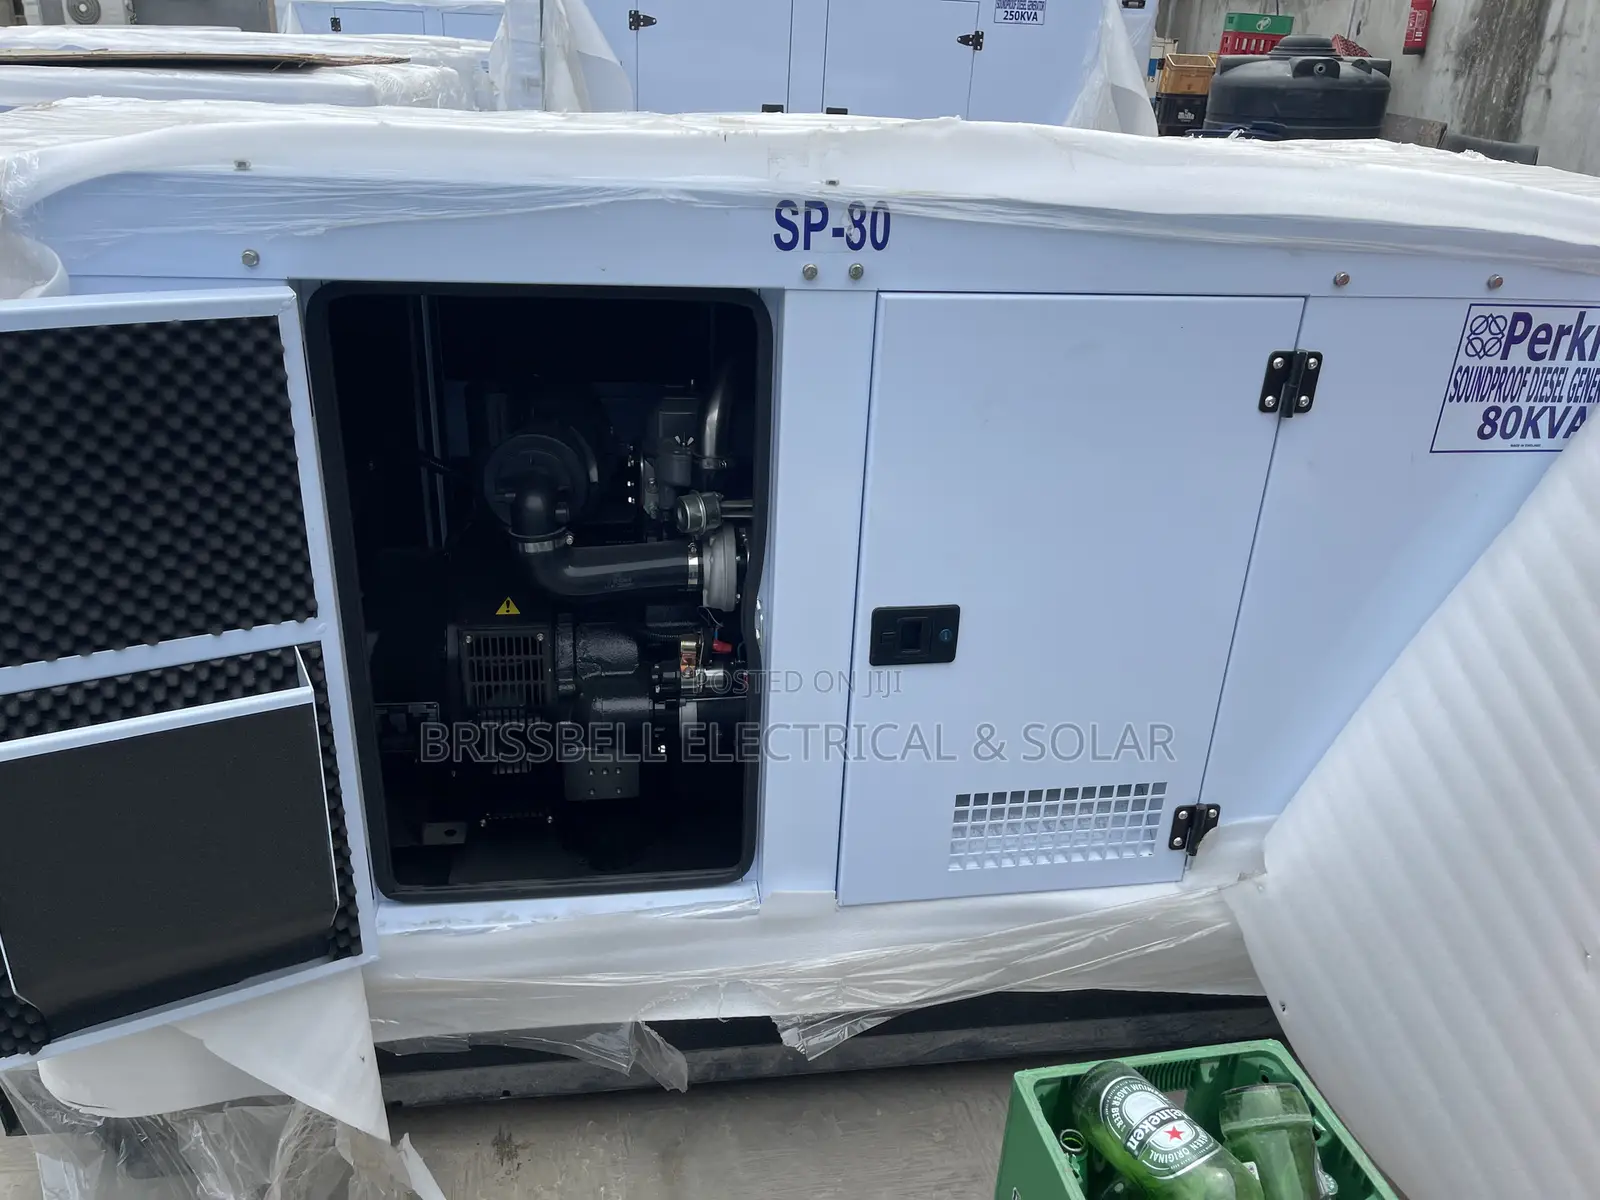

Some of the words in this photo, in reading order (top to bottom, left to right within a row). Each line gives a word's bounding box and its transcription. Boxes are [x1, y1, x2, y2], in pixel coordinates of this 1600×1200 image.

[1003, 10, 1038, 21] 250KVA
[773, 199, 891, 252] SP-80
[1448, 365, 1532, 404] SOUNDPROOF
[1526, 366, 1569, 404] DIESEL
[1476, 405, 1588, 440] 80KVA
[1113, 1085, 1131, 1105] LAGER
[1111, 1105, 1124, 1129] BEER
[1126, 1108, 1187, 1151] eineken
[1149, 1147, 1190, 1164] ORIGINAL
